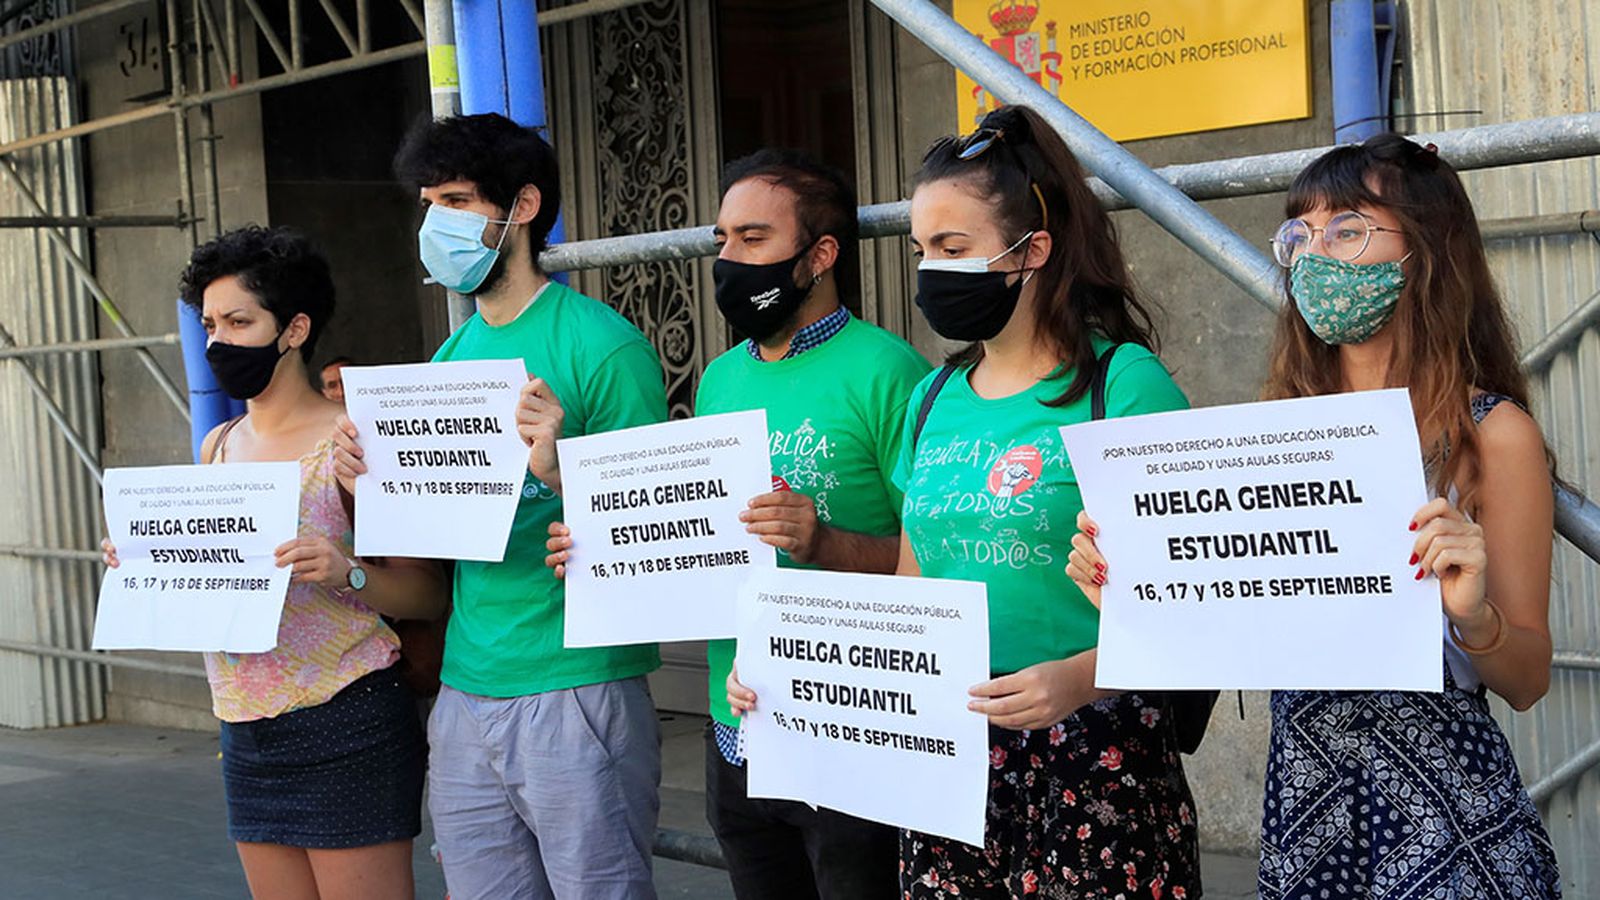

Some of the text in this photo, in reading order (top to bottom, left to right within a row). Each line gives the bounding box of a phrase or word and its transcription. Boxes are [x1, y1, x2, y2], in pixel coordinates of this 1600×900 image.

[1070, 11, 1150, 39] MINISTERIO
[1071, 27, 1185, 60] DE EDUCACIÓN
[1071, 33, 1287, 80] Y FORMACIÓN PROFESIONAL
[375, 417, 502, 436] HUELGA GENERAL
[1127, 443, 1176, 456] NUESTRO
[1175, 438, 1224, 452] DERECHO
[1226, 438, 1234, 448] A
[1235, 436, 1259, 447] UNA
[1261, 429, 1325, 445] EDUCACIÓN
[397, 450, 491, 467] ESTUDIANTIL
[1146, 450, 1334, 475] DE CALIDAD Y UNAS AULAS SEGURAS!
[382, 481, 513, 495] 16, 17 y 18 DE SEPTIEMBRE
[591, 479, 728, 512] HUELGA GENERAL
[1134, 480, 1362, 516] HUELGA GENERAL
[944, 492, 1034, 518] TOD@S
[130, 517, 257, 536] HUELGA GENERAL
[611, 518, 715, 545] ESTUDIANTIL
[150, 549, 244, 563] ESTUDIANTIL
[958, 539, 1053, 569] TOD@S
[1168, 530, 1338, 560] ESTUDIANTIL
[591, 550, 749, 578] 16, 17 y 18 DE SEPTIEMBRE
[123, 577, 270, 591] 16, 17 y 18 DE SEPTIEMBRE
[1134, 575, 1392, 602] 16, 17 y 18 DE SEPTIEMBRE
[806, 597, 844, 610] DERECHO
[845, 601, 851, 609] A
[853, 602, 871, 611] UNA
[873, 603, 922, 615] EDUCACIÓN
[781, 612, 793, 622] DE
[792, 614, 827, 625] CALIDAD
[827, 617, 833, 625] Y
[835, 618, 857, 628] UNAS
[859, 620, 887, 631] AULAS
[770, 637, 941, 675] HUELGA GENERAL
[792, 679, 916, 715] ESTUDIANTIL
[773, 712, 955, 756] 16, 17 y 18 DE SEPTIEMBRE
